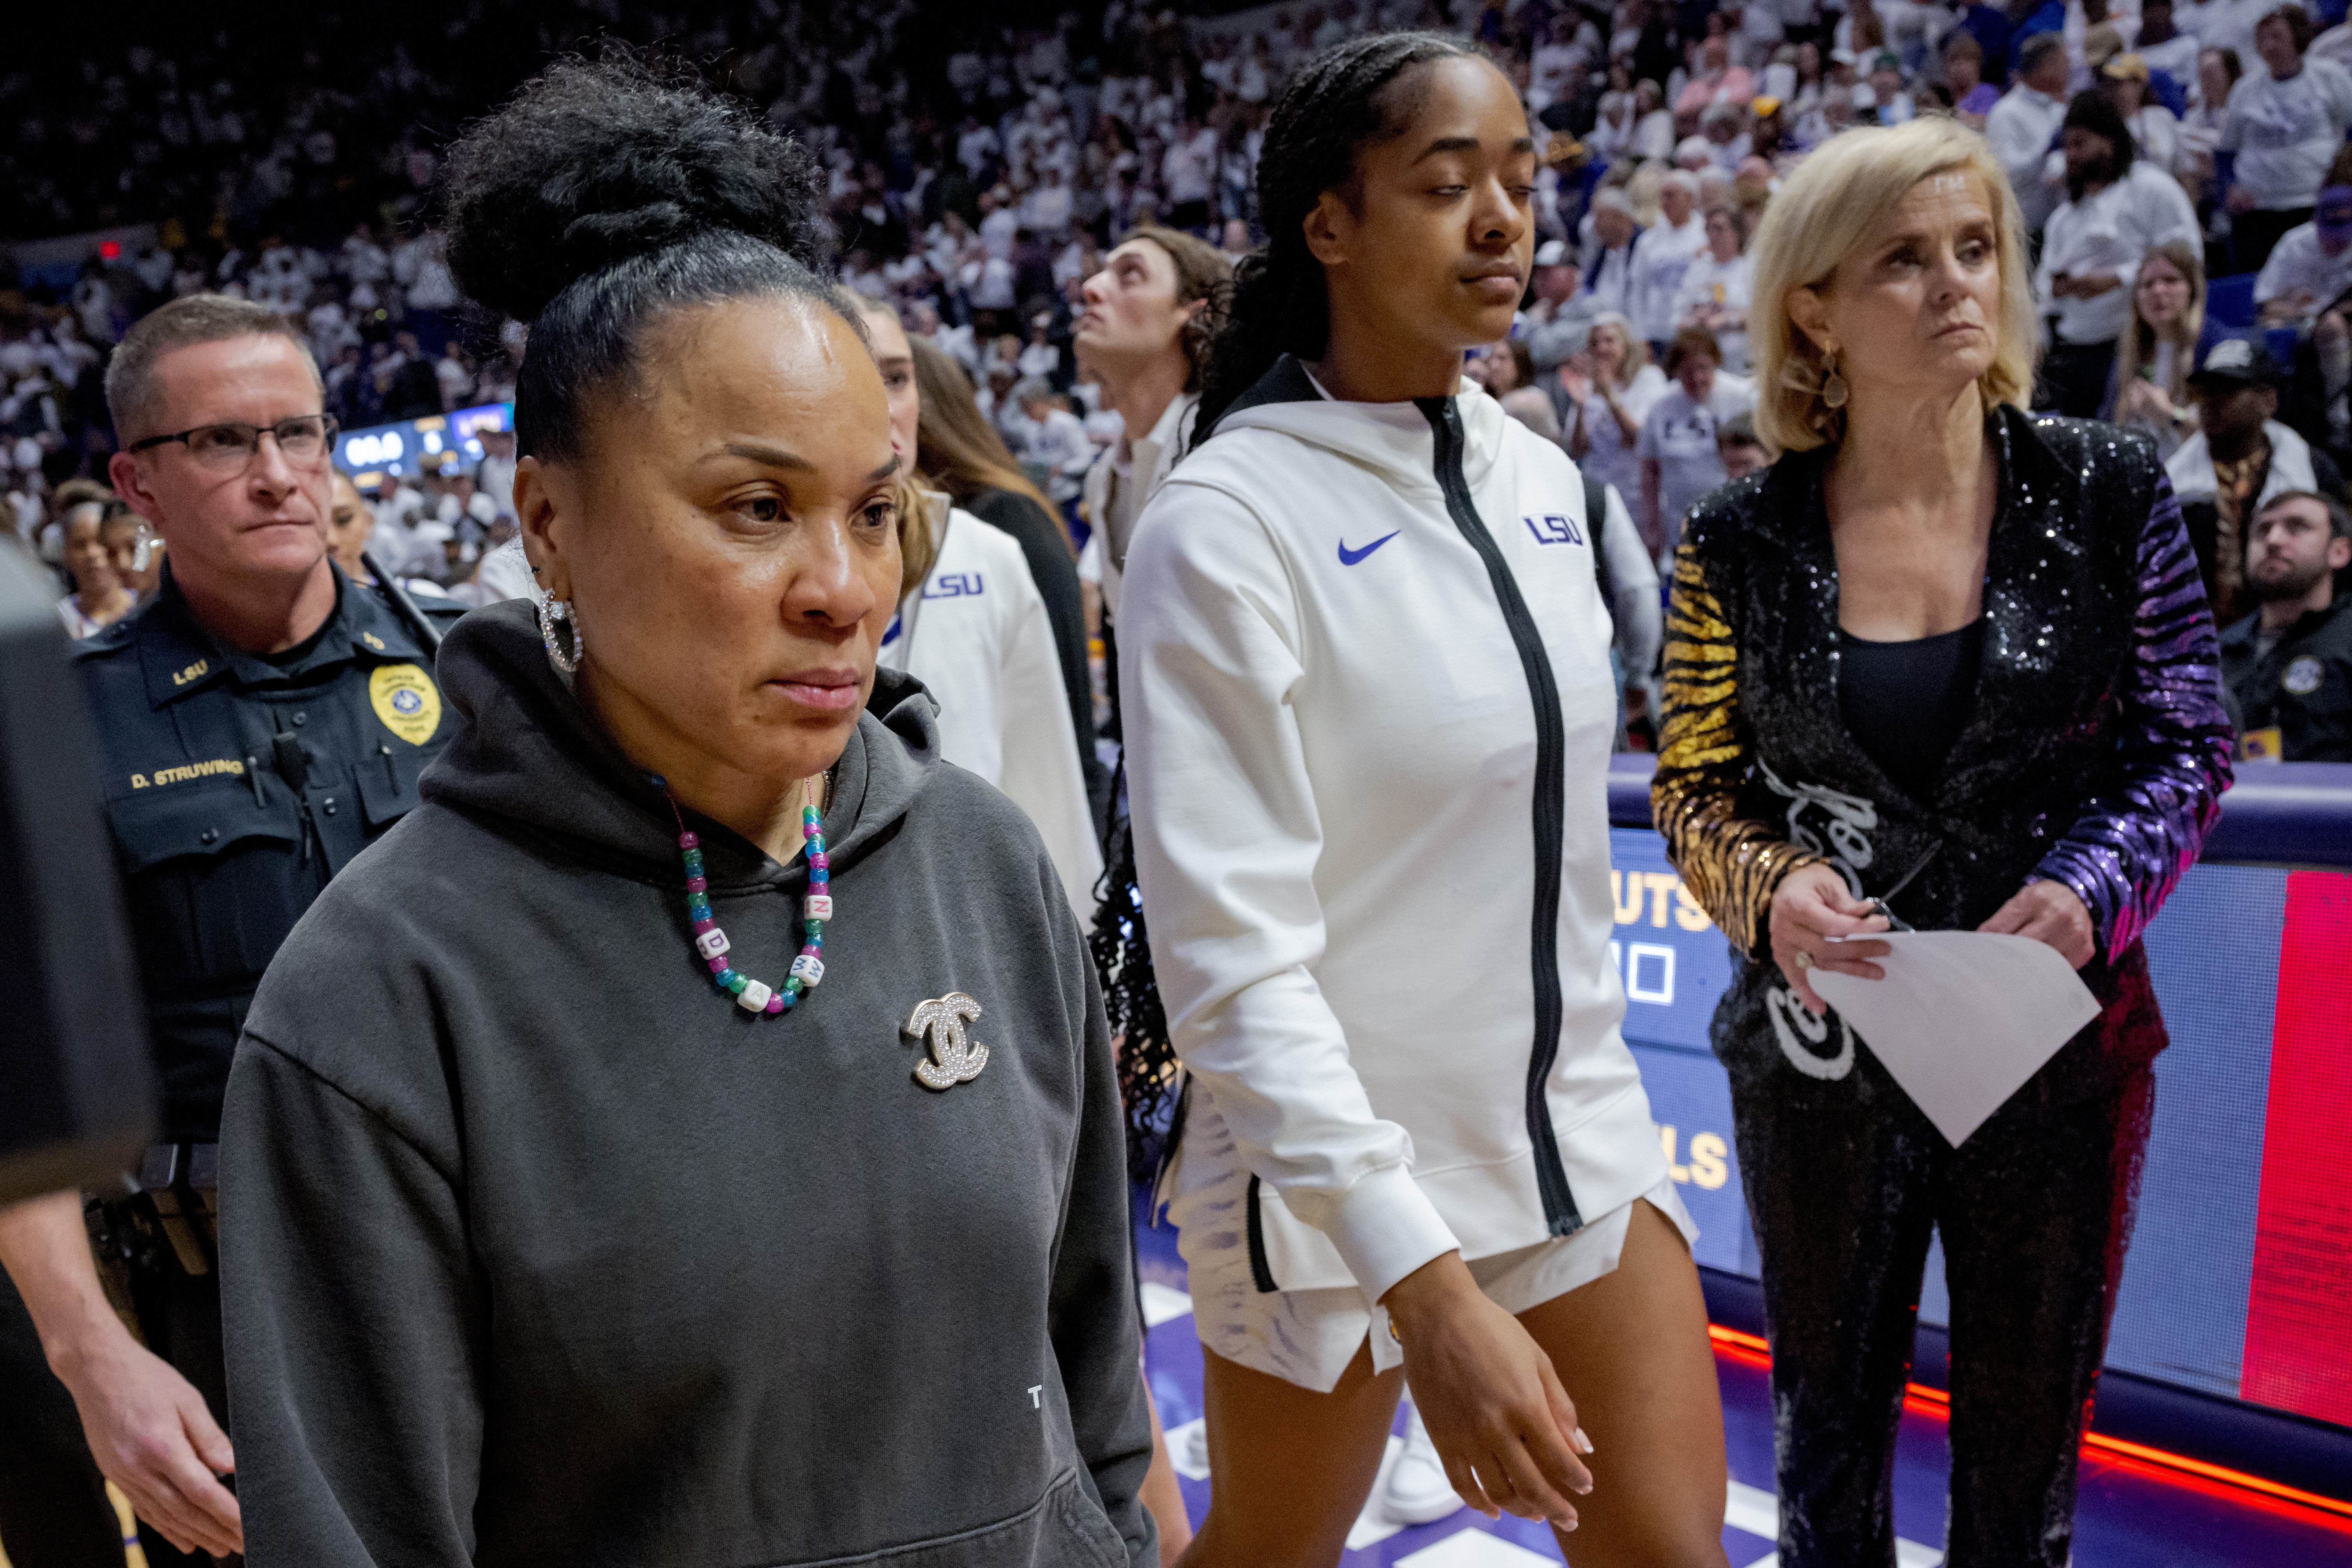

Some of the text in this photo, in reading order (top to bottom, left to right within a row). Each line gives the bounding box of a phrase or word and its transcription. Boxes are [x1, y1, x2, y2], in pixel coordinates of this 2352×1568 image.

[1523, 516, 1584, 546] LSU
[173, 658, 208, 686] LSU
[131, 759, 244, 789] D. STRUWING
[1027, 1384, 1042, 1410] T
